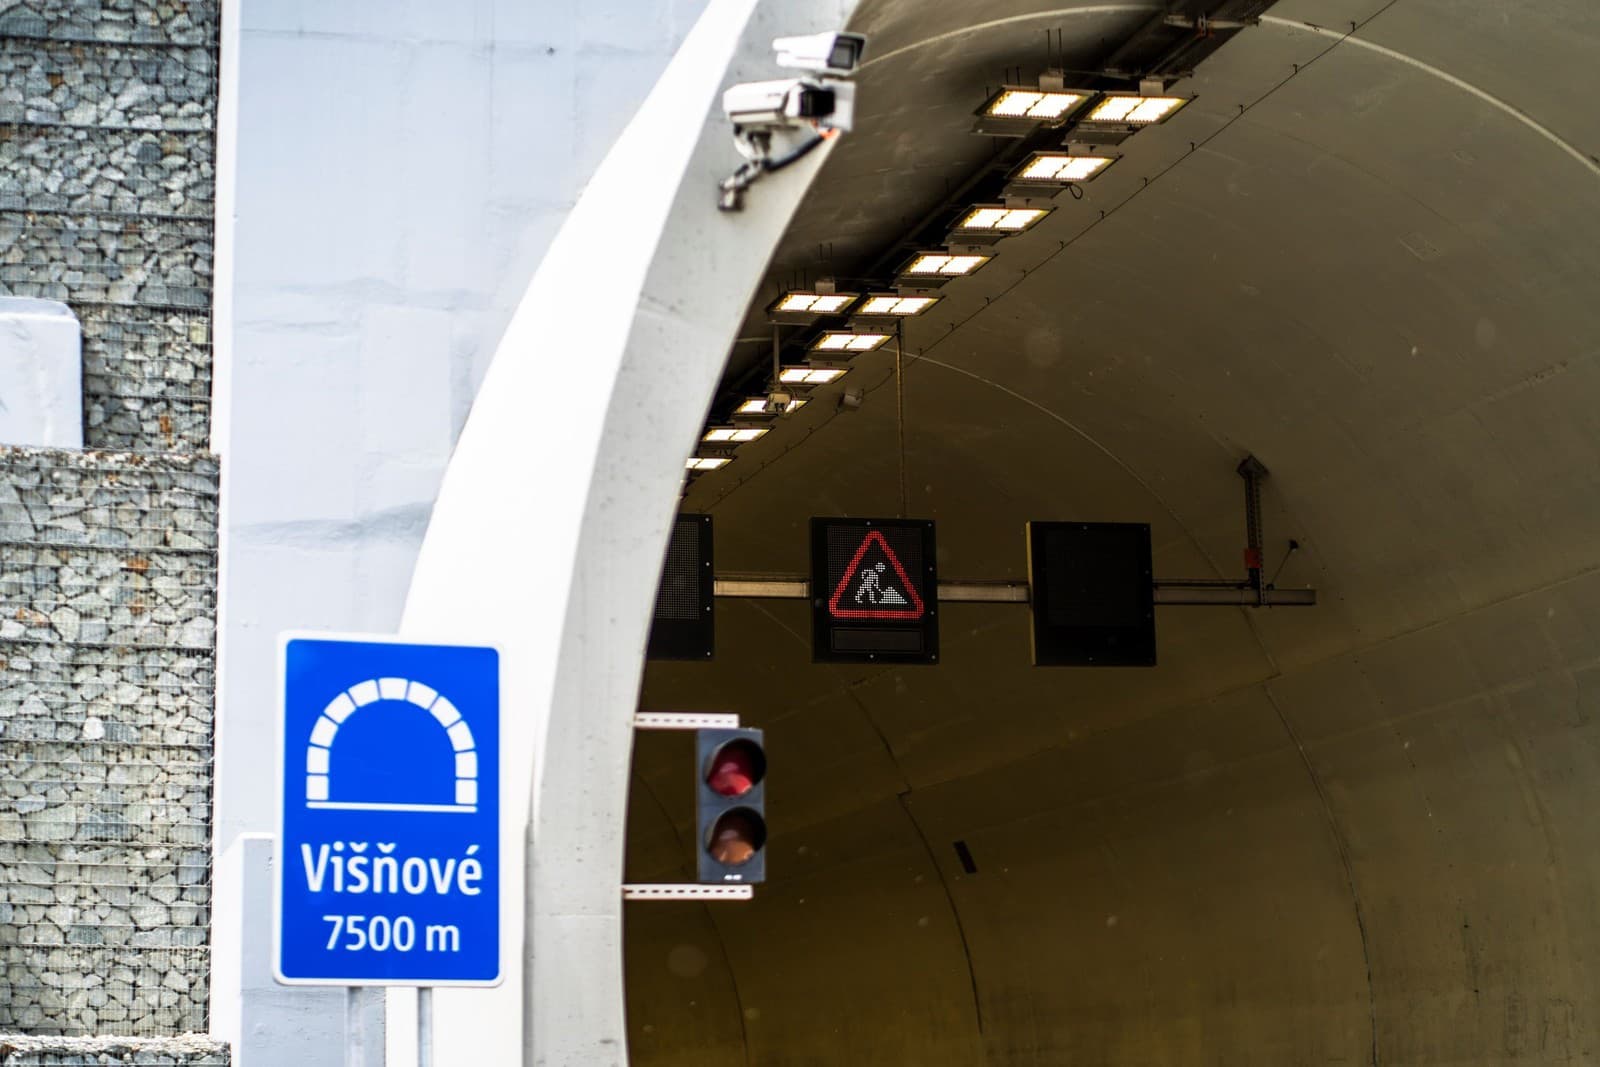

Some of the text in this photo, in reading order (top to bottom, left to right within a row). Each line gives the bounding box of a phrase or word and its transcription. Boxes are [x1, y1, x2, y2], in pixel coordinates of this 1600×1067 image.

[300, 841, 483, 895] Višňové
[323, 915, 460, 952] 7500 m
